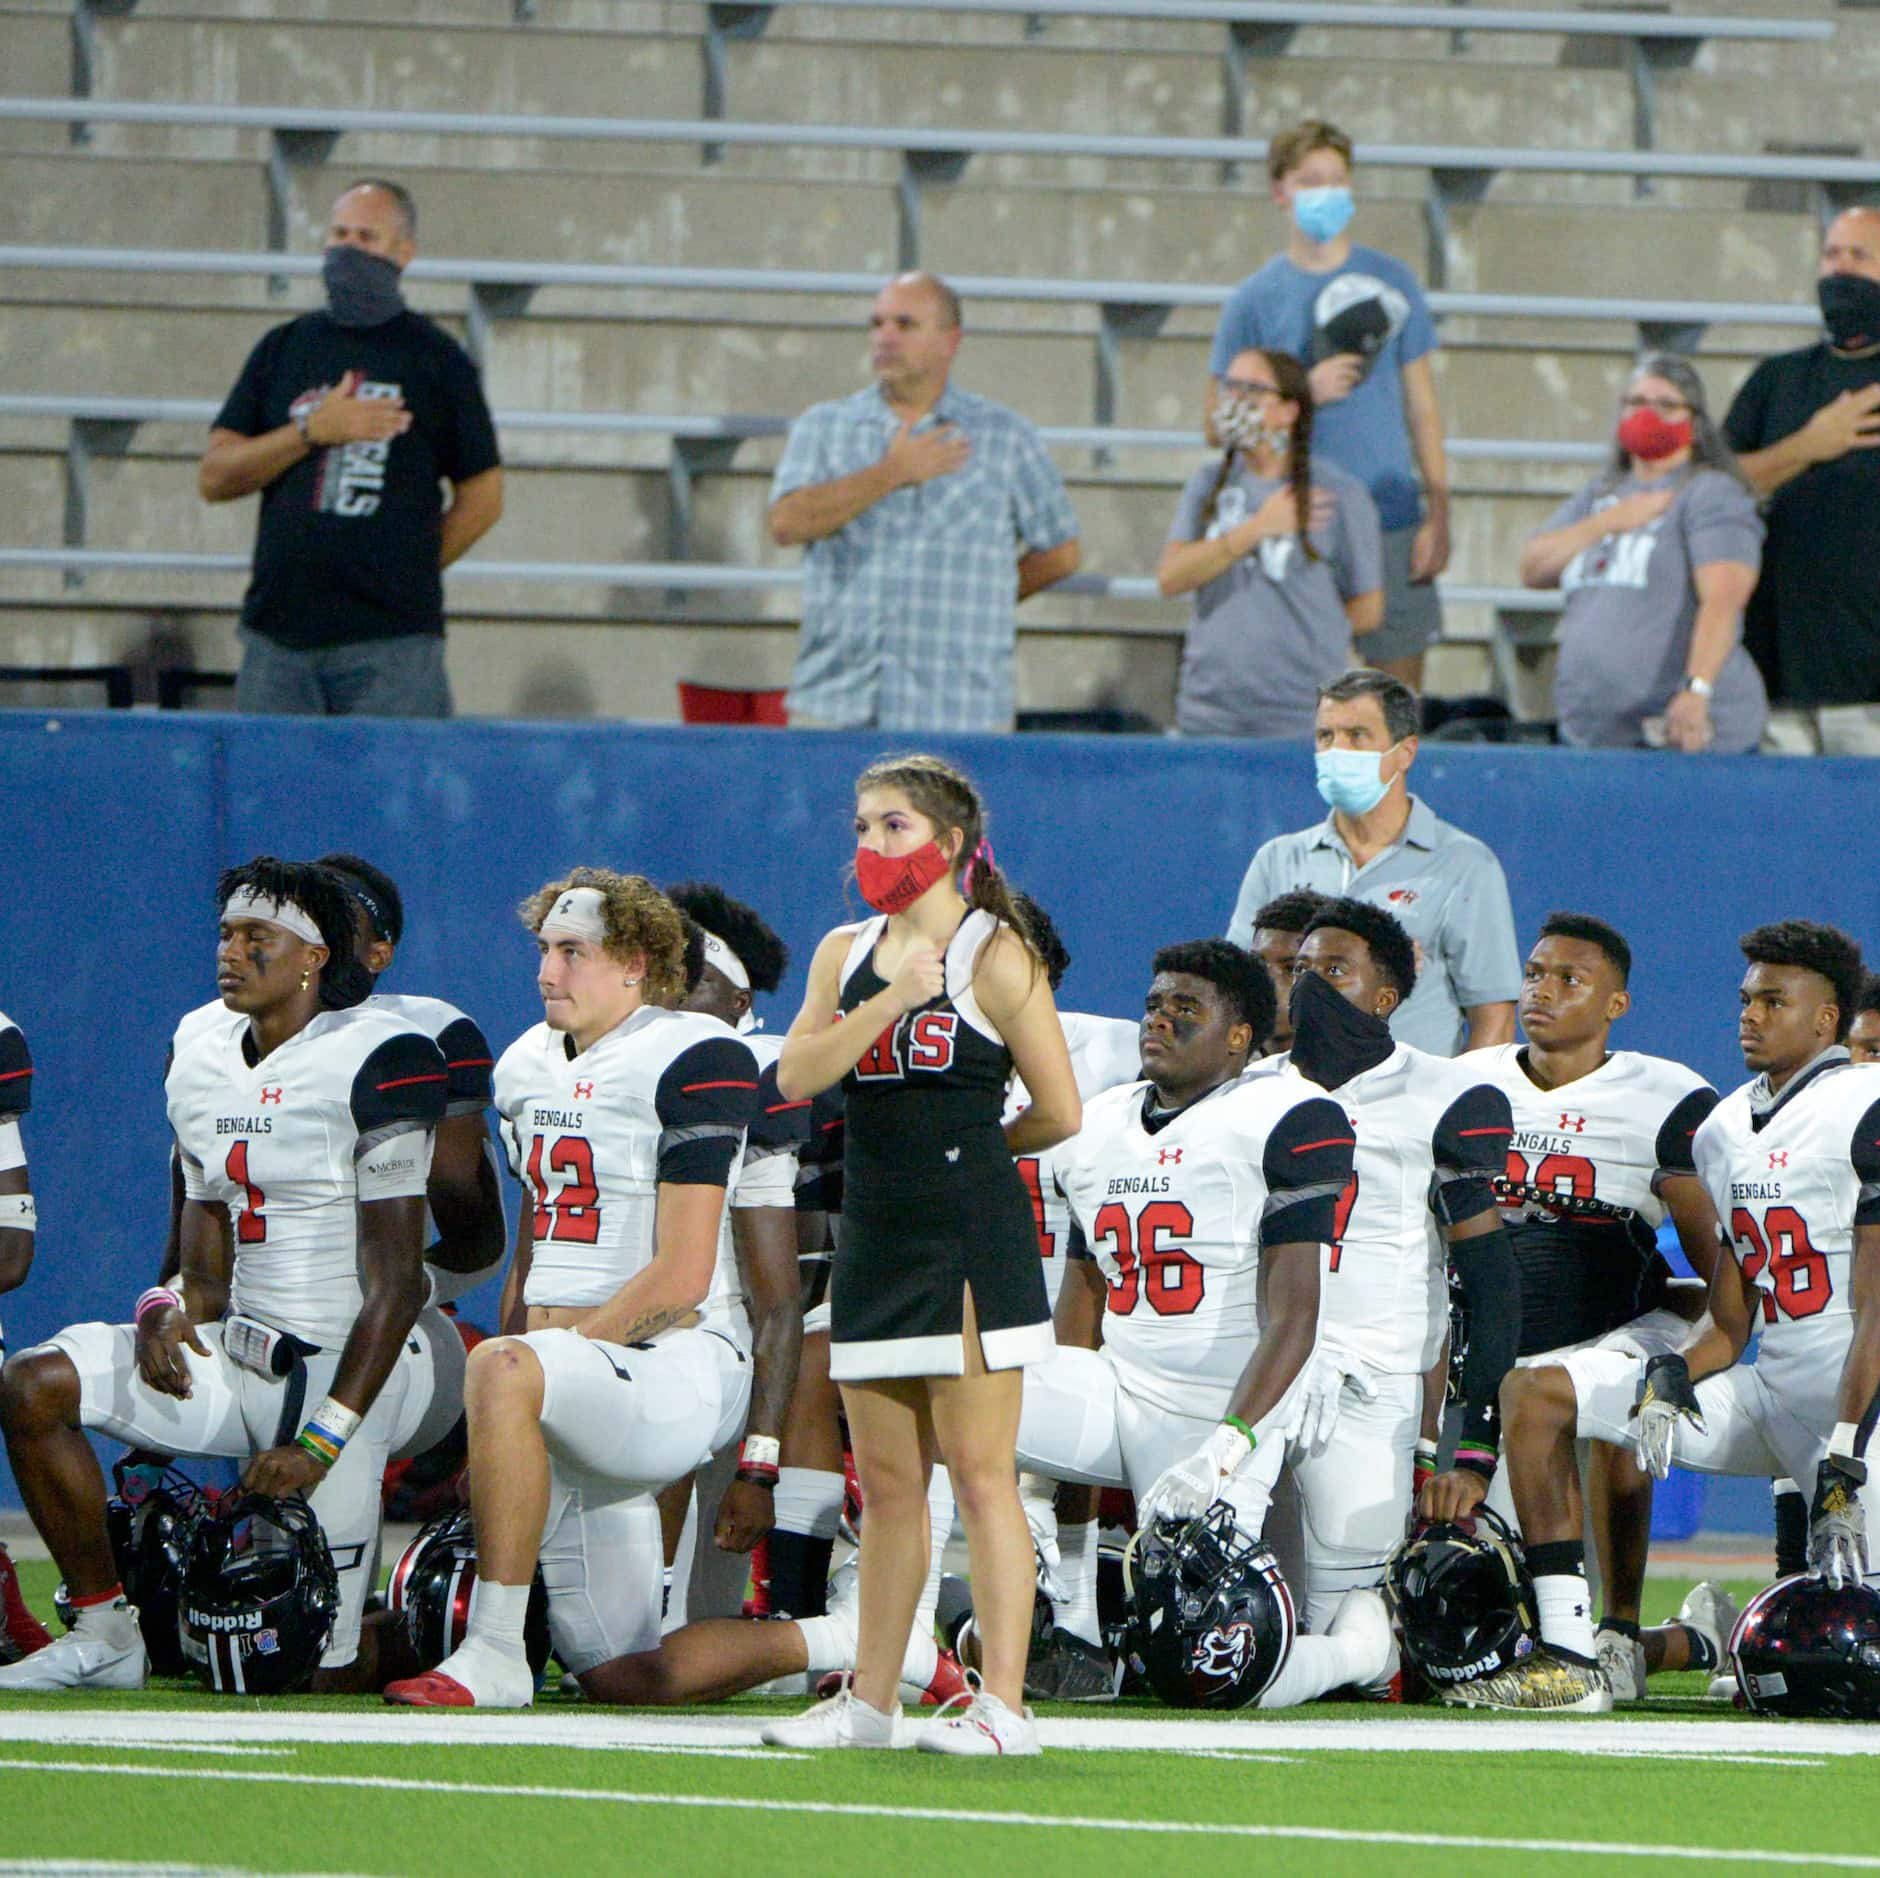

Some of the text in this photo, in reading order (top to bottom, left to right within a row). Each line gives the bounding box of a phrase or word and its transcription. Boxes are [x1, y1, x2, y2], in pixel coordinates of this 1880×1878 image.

[216, 1117, 273, 1135] BENGALS
[534, 1110, 583, 1129] BENGALS
[1509, 1132, 1572, 1155] ENGALS
[225, 1140, 267, 1244] 1
[527, 1133, 602, 1245] 12
[1107, 1176, 1171, 1195] BENGALS
[1731, 1183, 1782, 1200] BENGALS
[1094, 1200, 1205, 1316] 36
[1732, 1205, 1834, 1325] 28
[188, 1607, 263, 1633] Riddell
[1425, 1650, 1502, 1682] Riddell
